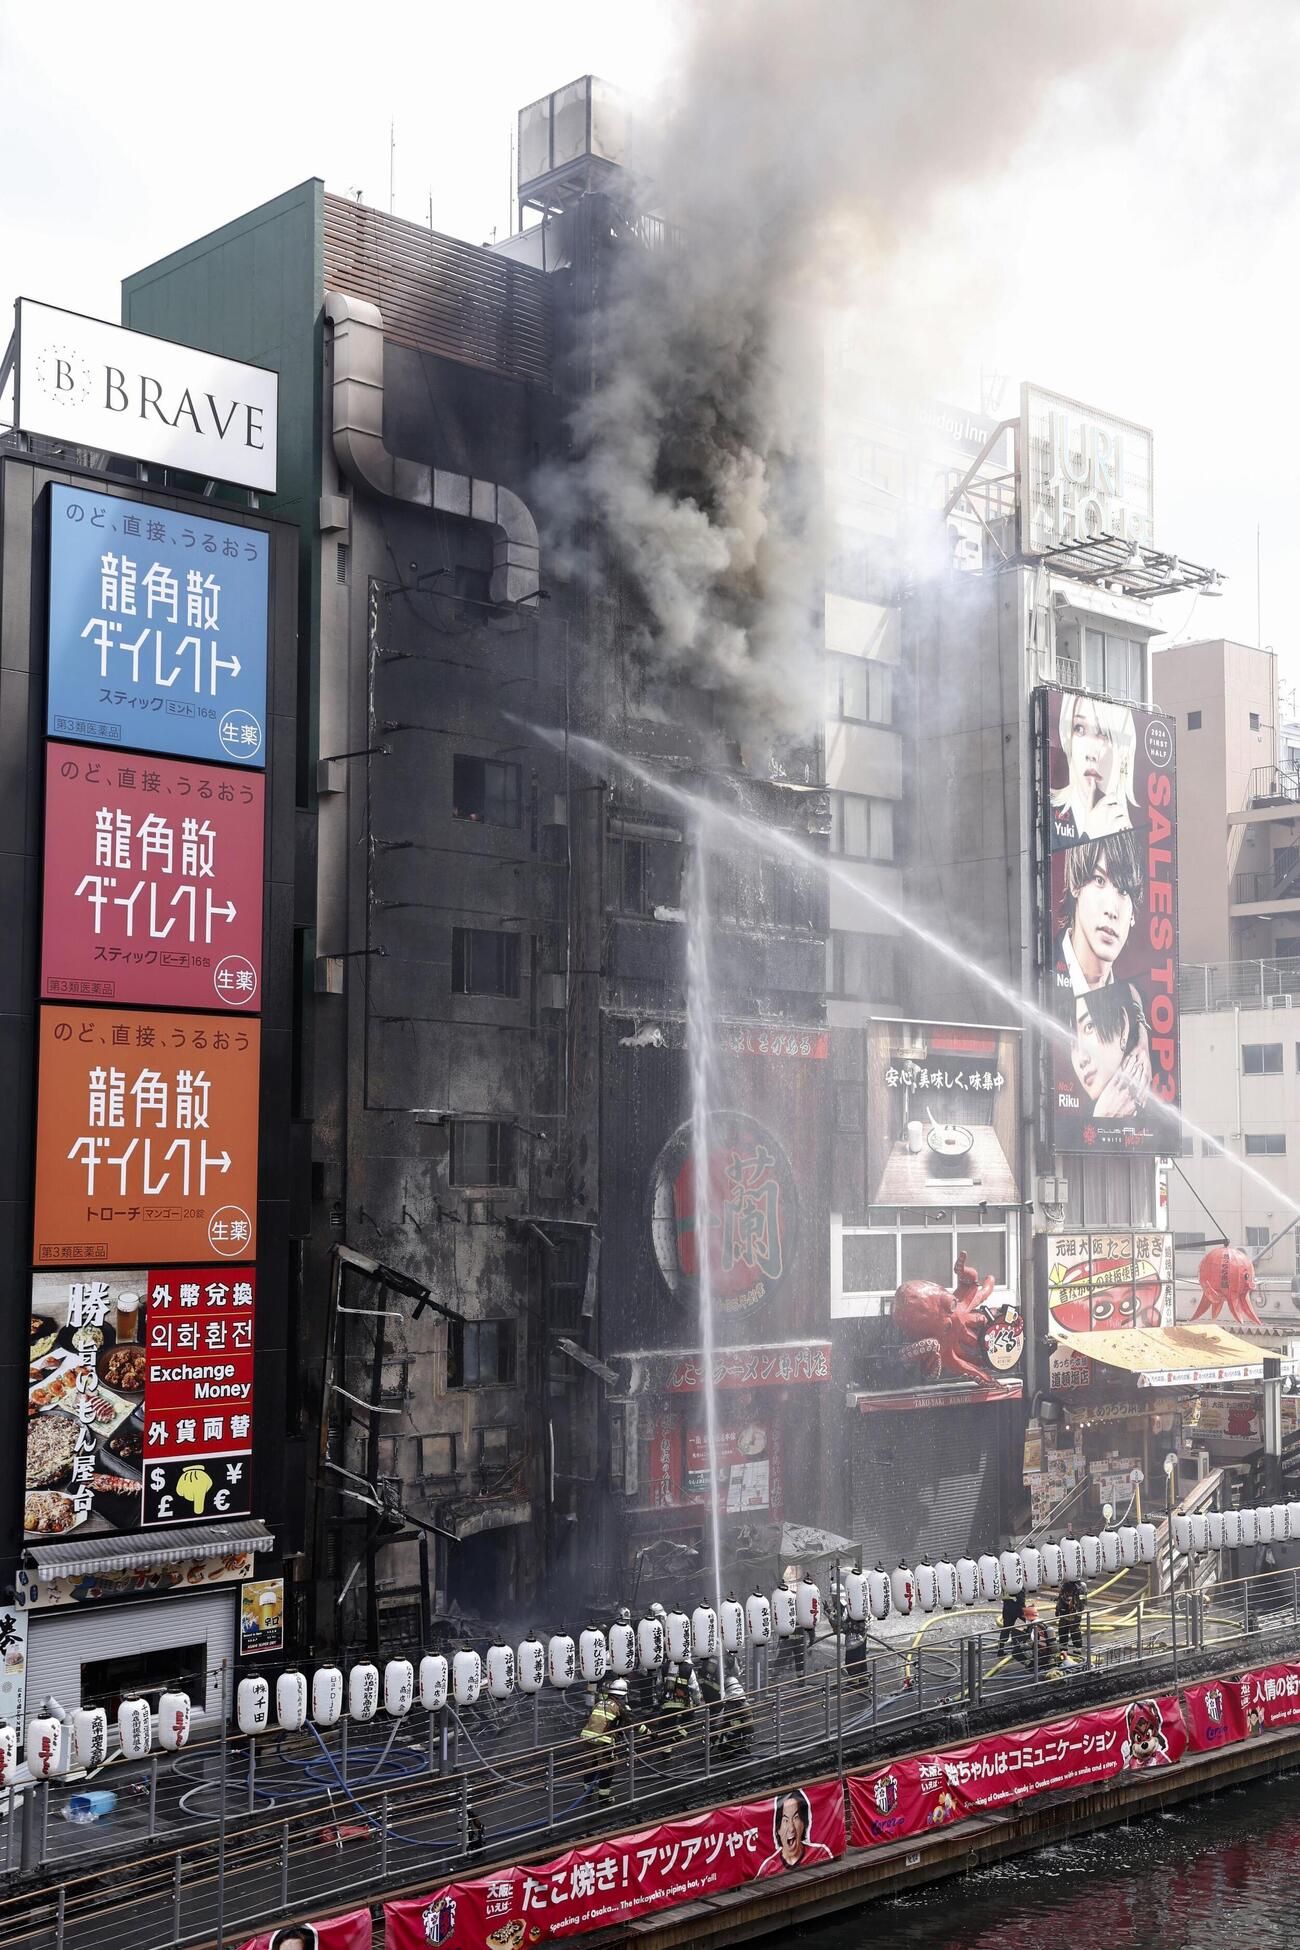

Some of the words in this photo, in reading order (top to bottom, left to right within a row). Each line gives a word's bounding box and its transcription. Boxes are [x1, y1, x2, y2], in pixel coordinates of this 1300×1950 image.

[56, 359, 74, 392] B
[103, 365, 264, 450] BRAVE
[966, 418, 988, 446] Inn
[66, 503, 259, 561] のど、直接、うるおう
[101, 551, 221, 631] 龍角散
[81, 618, 242, 696] ダイレクト
[99, 688, 164, 712] スティック
[168, 702, 195, 716] ミント
[56, 718, 120, 739] 第3類医薬品
[222, 722, 259, 745] 生薬
[1151, 729, 1166, 738] 2024
[1150, 739, 1168, 748] FIRST
[1151, 749, 1167, 758] HALF
[61, 761, 255, 804] のど、直接、うるおう
[95, 807, 217, 878] 龍角散
[1055, 822, 1075, 838] Yuki
[1148, 772, 1173, 950] SALES
[74, 875, 237, 944] ダイレクト
[94, 946, 158, 965] スティック
[49, 979, 113, 995] 第3類医薬品
[217, 969, 254, 991] 生薬
[54, 1022, 250, 1051] のど、直接、うるおう
[1151, 958, 1177, 1103] TOP3
[885, 1067, 1005, 1092] 安心、美味しく、味集中
[89, 1066, 211, 1130] 龍角散
[1058, 1094, 1079, 1108] Riku
[67, 1137, 232, 1196] ダイレクト
[87, 1207, 141, 1222] トローチ
[145, 1208, 181, 1220] マンゴー
[676, 1146, 783, 1280] 一蘭
[211, 1221, 248, 1241] 生薬
[42, 1246, 106, 1258] 第3類医薬品
[67, 1282, 110, 1328] 勝
[152, 1283, 253, 1309] 外幣兌換
[151, 1320, 252, 1351] 외화환전
[150, 1364, 235, 1382] Exchange
[195, 1383, 251, 1400] Money
[149, 1415, 250, 1446] 外貨両替
[151, 1467, 166, 1491] $
[226, 1463, 243, 1484] ¥
[157, 1495, 174, 1518] £
[214, 1489, 231, 1511] €
[504, 1653, 514, 1690] 法善寺
[533, 1648, 544, 1683] 法善寺
[564, 1644, 575, 1679] 法善寺
[1252, 1675, 1300, 1704] 人情の街
[919, 1765, 943, 1778] 大阪と
[1014, 1786, 1029, 1796] Candy
[1035, 1779, 1050, 1788] Osaka
[1064, 1771, 1074, 1780] with
[1079, 1766, 1091, 1776] smile
[1091, 1763, 1102, 1772] and
[487, 1884, 513, 1899] 大阪と
[550, 1915, 580, 1935] Speaking
[582, 1909, 590, 1922] of
[620, 1899, 634, 1910] The
[634, 1888, 667, 1906] takoyaki's
[666, 1883, 688, 1898] piping
[688, 1878, 701, 1890] hot,
